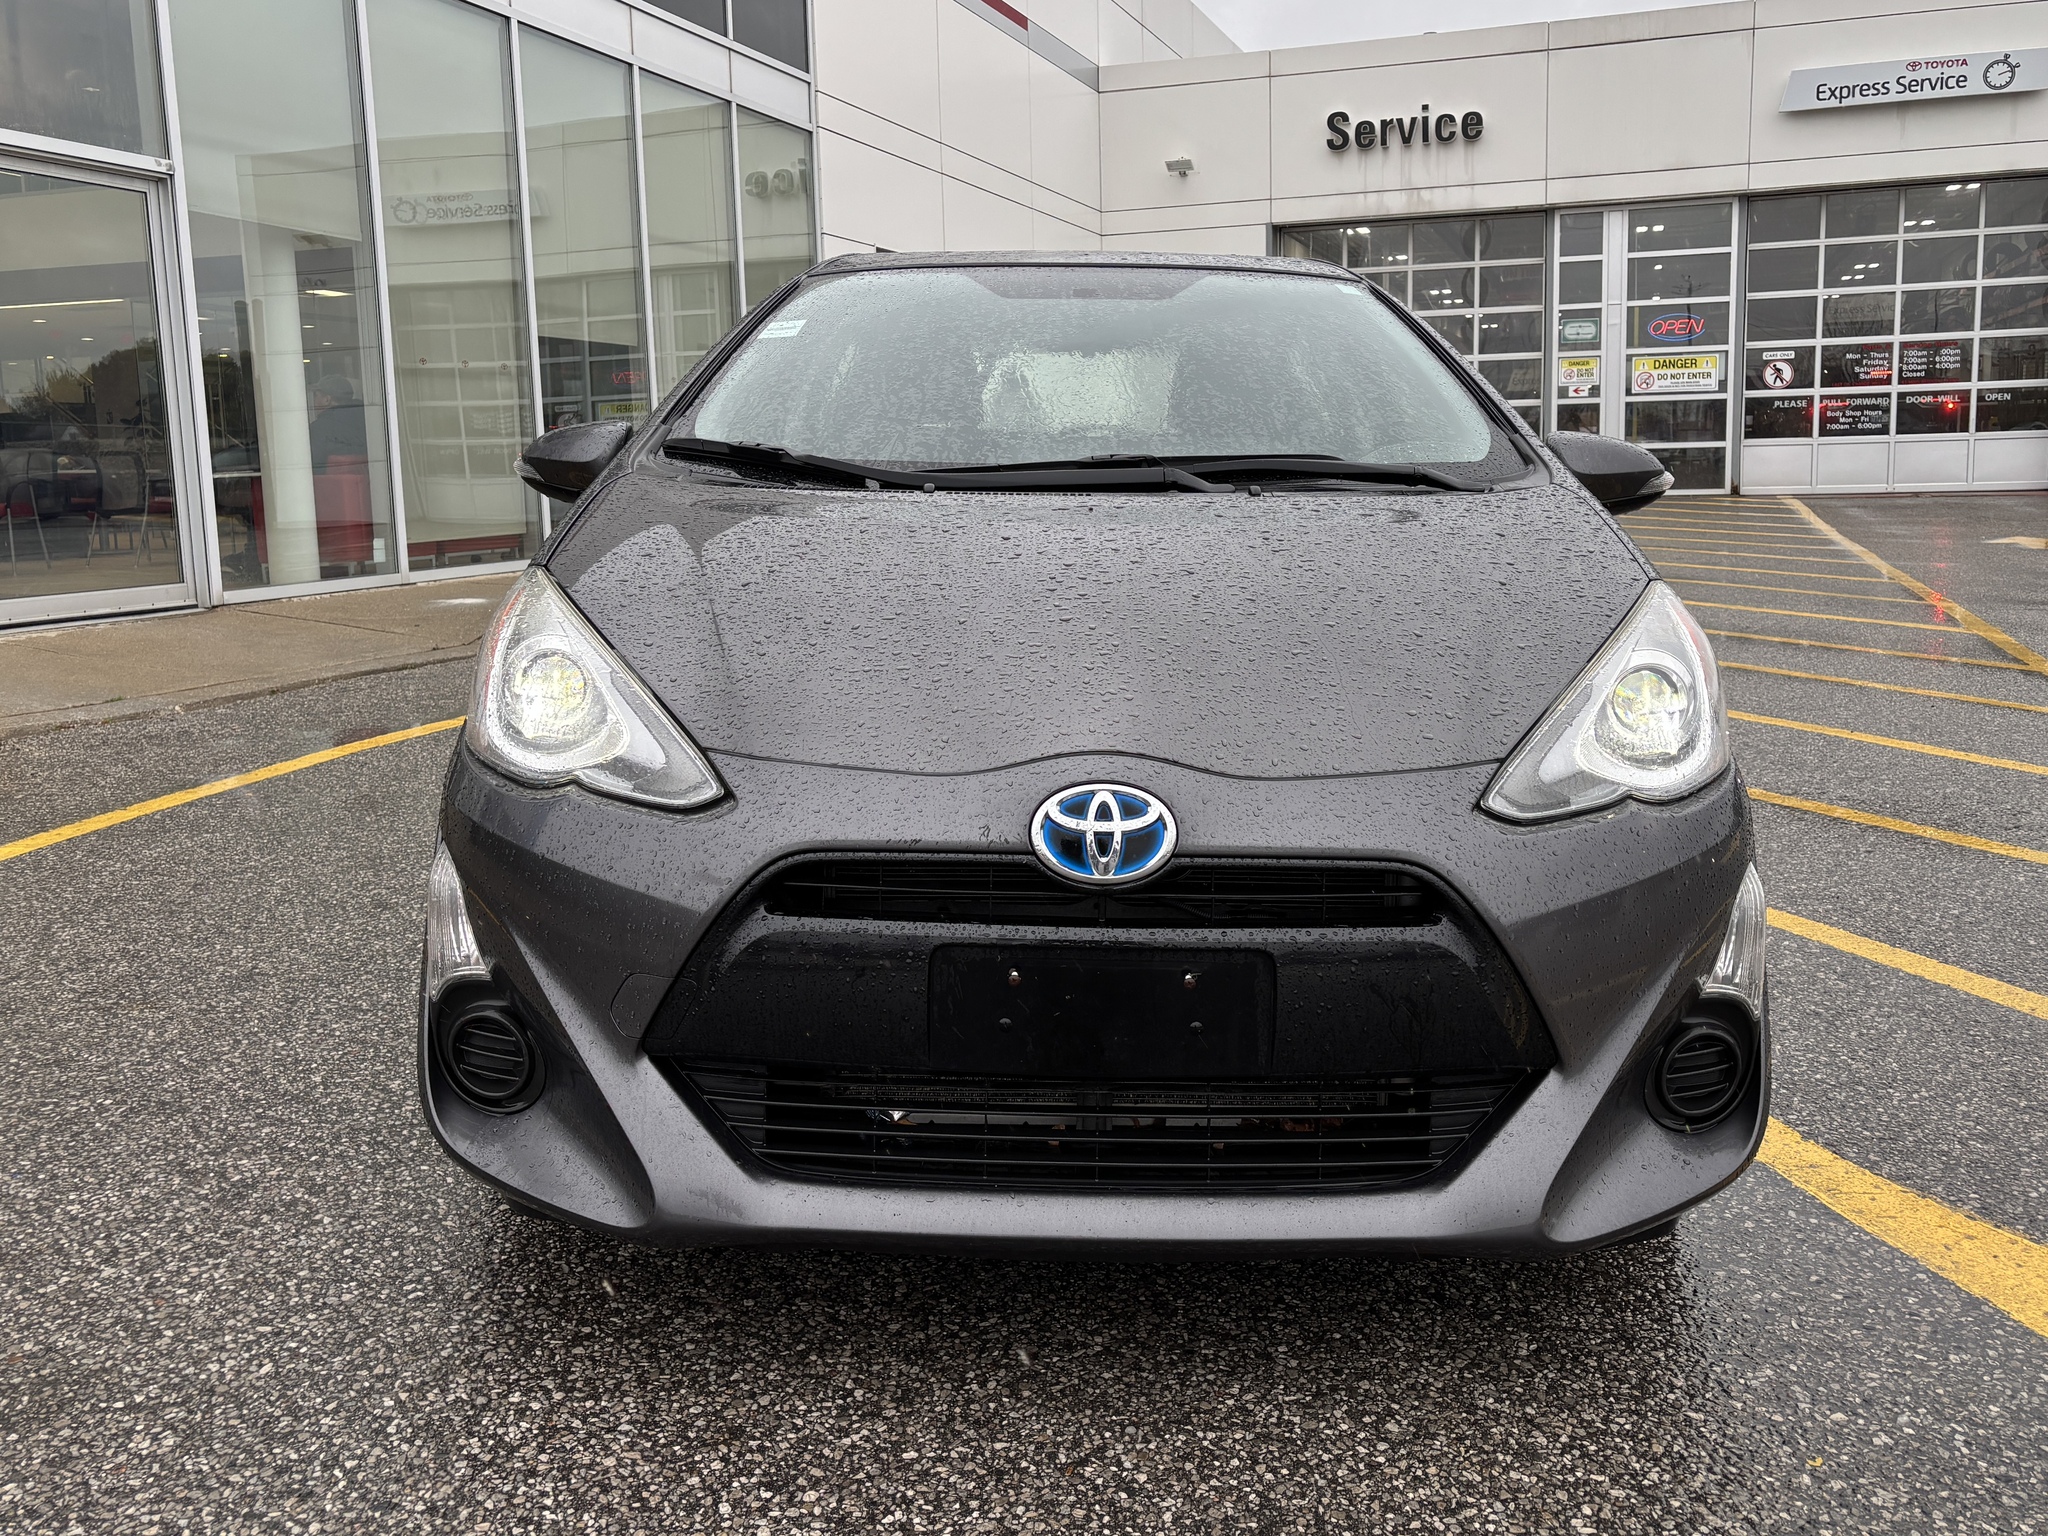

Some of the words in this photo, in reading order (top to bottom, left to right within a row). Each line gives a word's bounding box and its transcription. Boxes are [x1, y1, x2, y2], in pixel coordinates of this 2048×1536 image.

[1925, 58, 1968, 70] TOYOTA
[1816, 80, 1890, 104] Express
[1896, 72, 1968, 95] Service
[1326, 104, 1484, 151] Service
[1650, 319, 1704, 335] OPEN
[1653, 358, 1697, 369] DANGER
[1774, 400, 1808, 408] PLEASE
